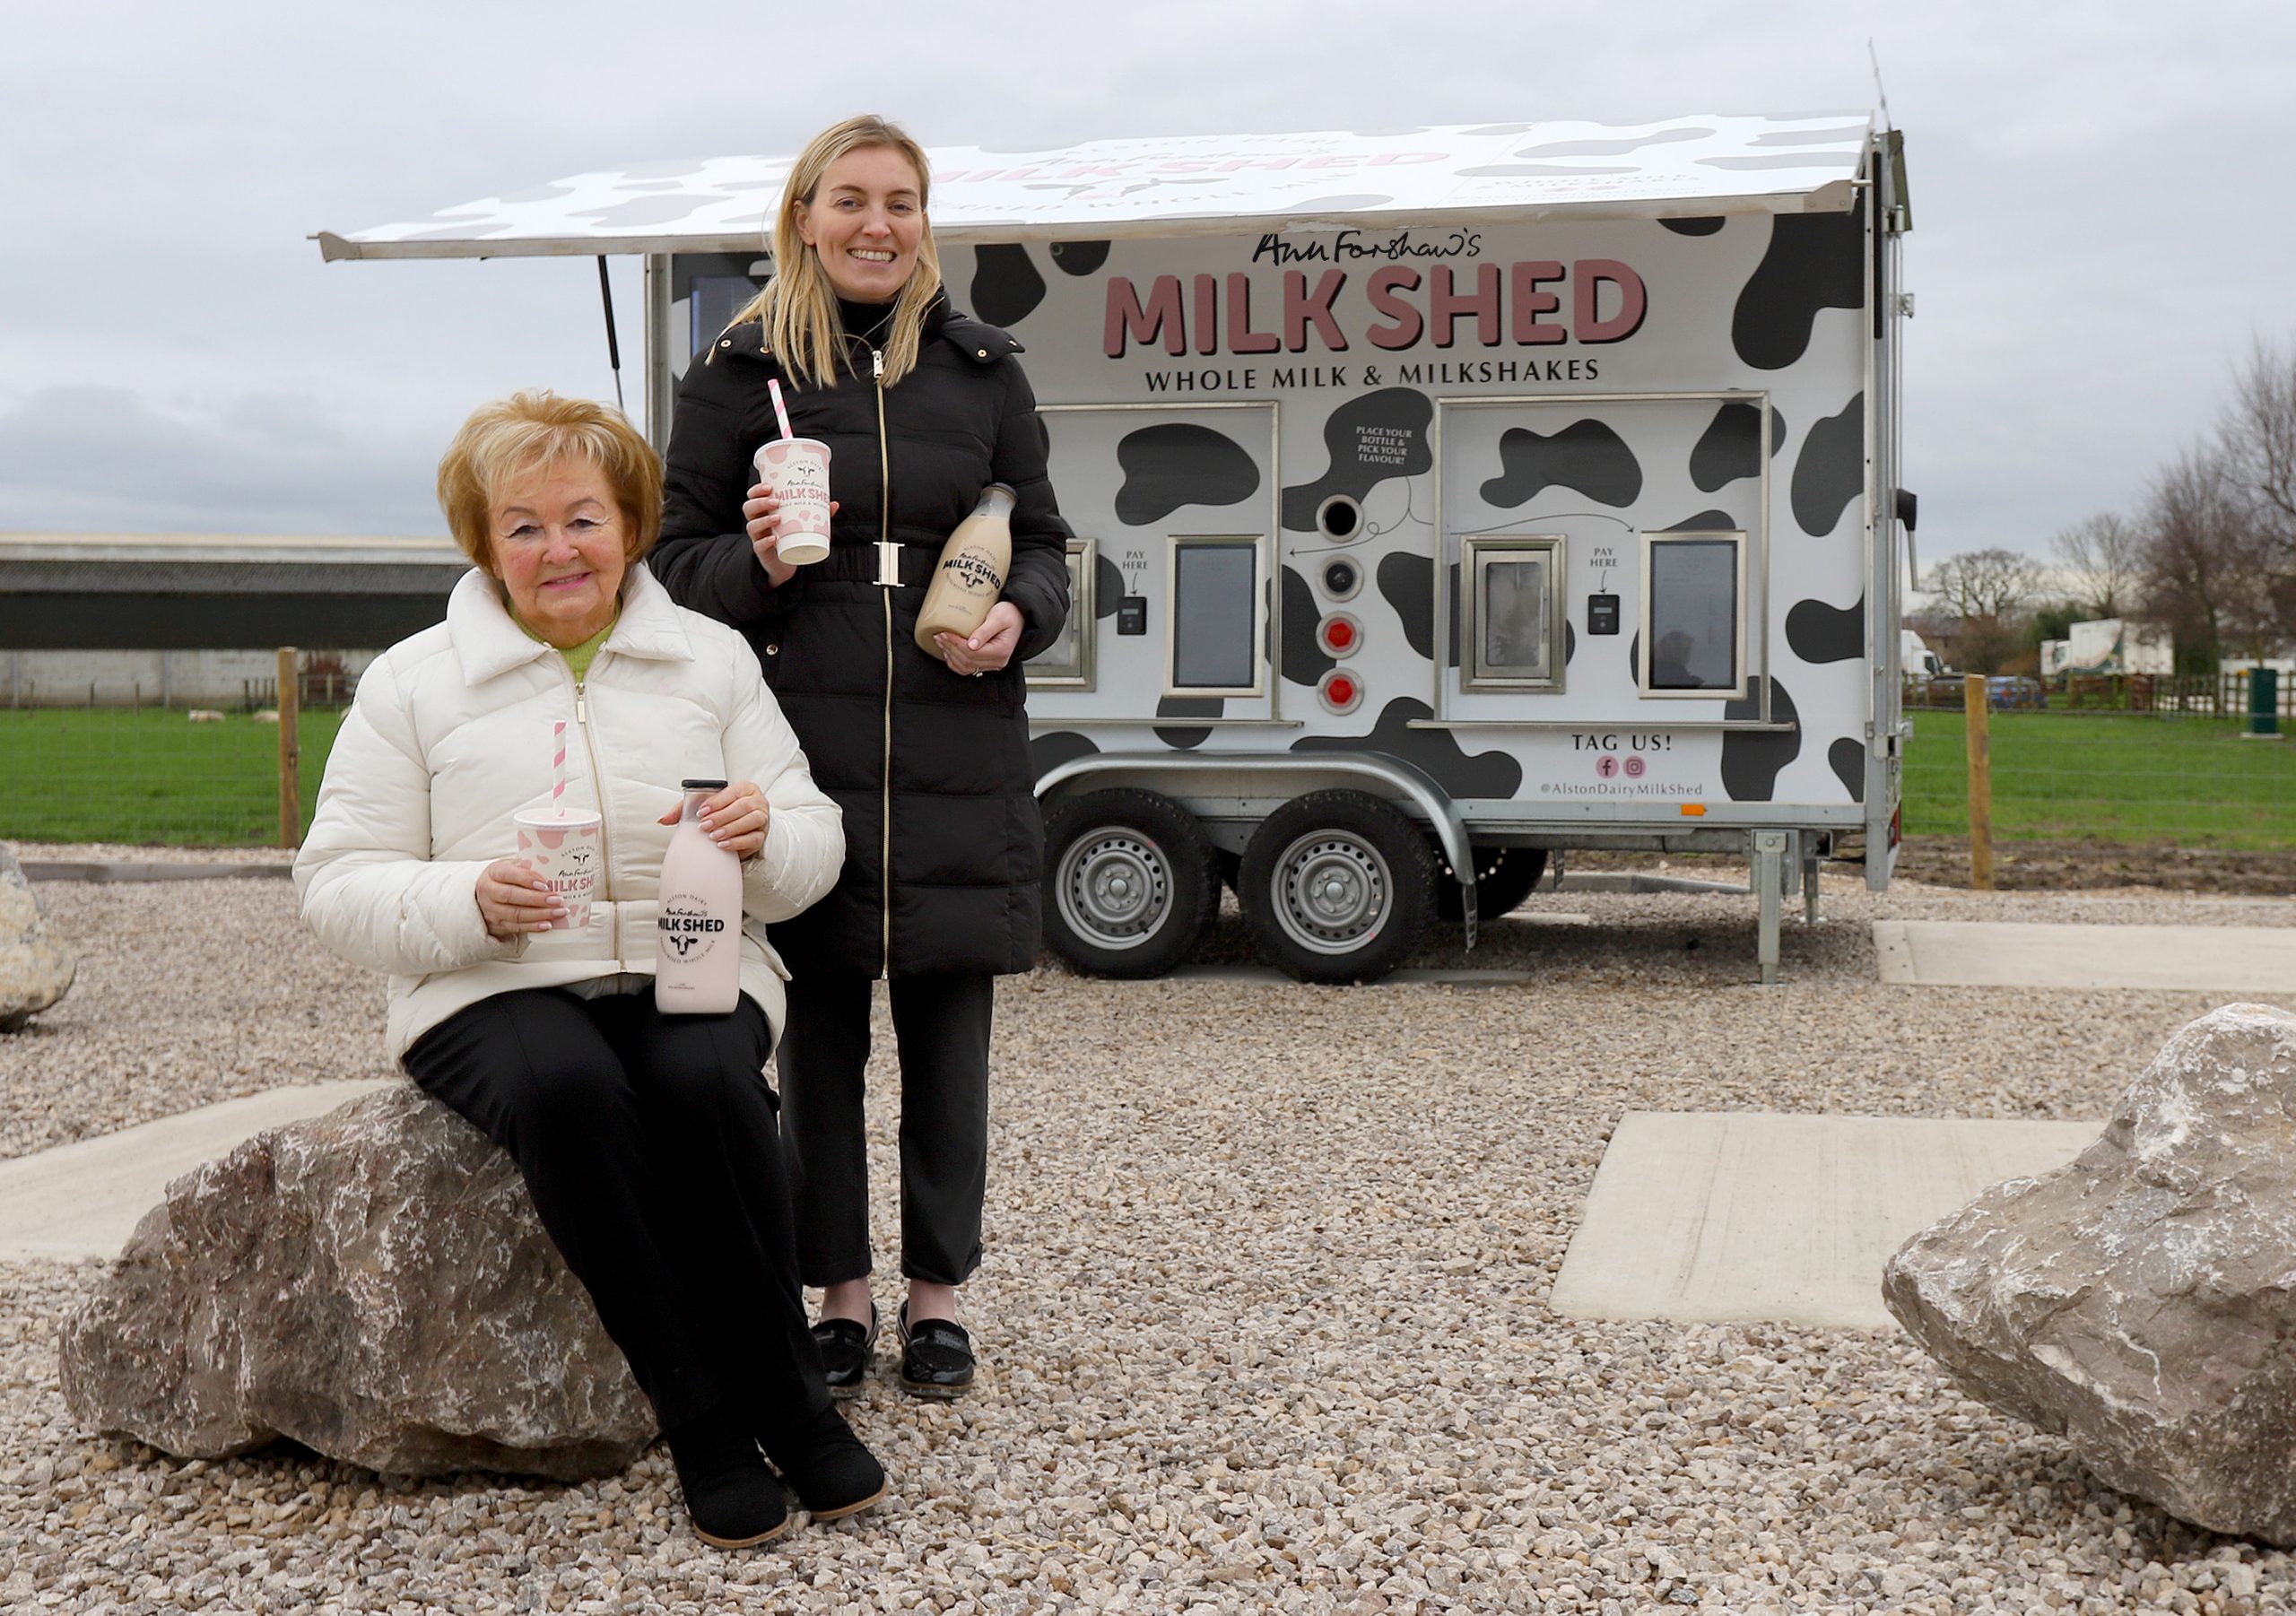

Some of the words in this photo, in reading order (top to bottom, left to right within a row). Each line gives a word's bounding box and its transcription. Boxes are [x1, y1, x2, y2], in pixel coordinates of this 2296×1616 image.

[1145, 152, 1451, 174] SHED
[1252, 233, 1329, 266] Ann
[1334, 227, 1482, 263] Forshaw's
[1102, 268, 1350, 359] MILK
[1365, 258, 1648, 352] SHED
[1145, 369, 1256, 392] WHOLE
[1272, 366, 1347, 388] MILK
[1362, 365, 1382, 386] &
[1398, 359, 1599, 384] MILKSHAKES
[1356, 426, 1385, 436] PLACE
[1386, 429, 1413, 438] YOUR
[1361, 436, 1396, 446] BOTTLE
[1358, 445, 1379, 454] PICK
[1381, 447, 1407, 456] YOUR
[1358, 454, 1405, 465] FLAVOUR!
[775, 488, 806, 500] MILK
[1126, 551, 1144, 559] PAY
[1594, 547, 1613, 556] PAY
[1122, 560, 1148, 569] HERE
[1590, 558, 1618, 567] HERE
[942, 559, 974, 569] MILK
[974, 564, 1001, 590] SHED
[1571, 734, 1618, 751] TAG
[1631, 734, 1672, 751] US!
[1540, 783, 1703, 797] @AlstonDairyMilkShed
[579, 875, 595, 890] SH
[657, 917, 681, 931] MILK
[683, 918, 725, 932] SHED
